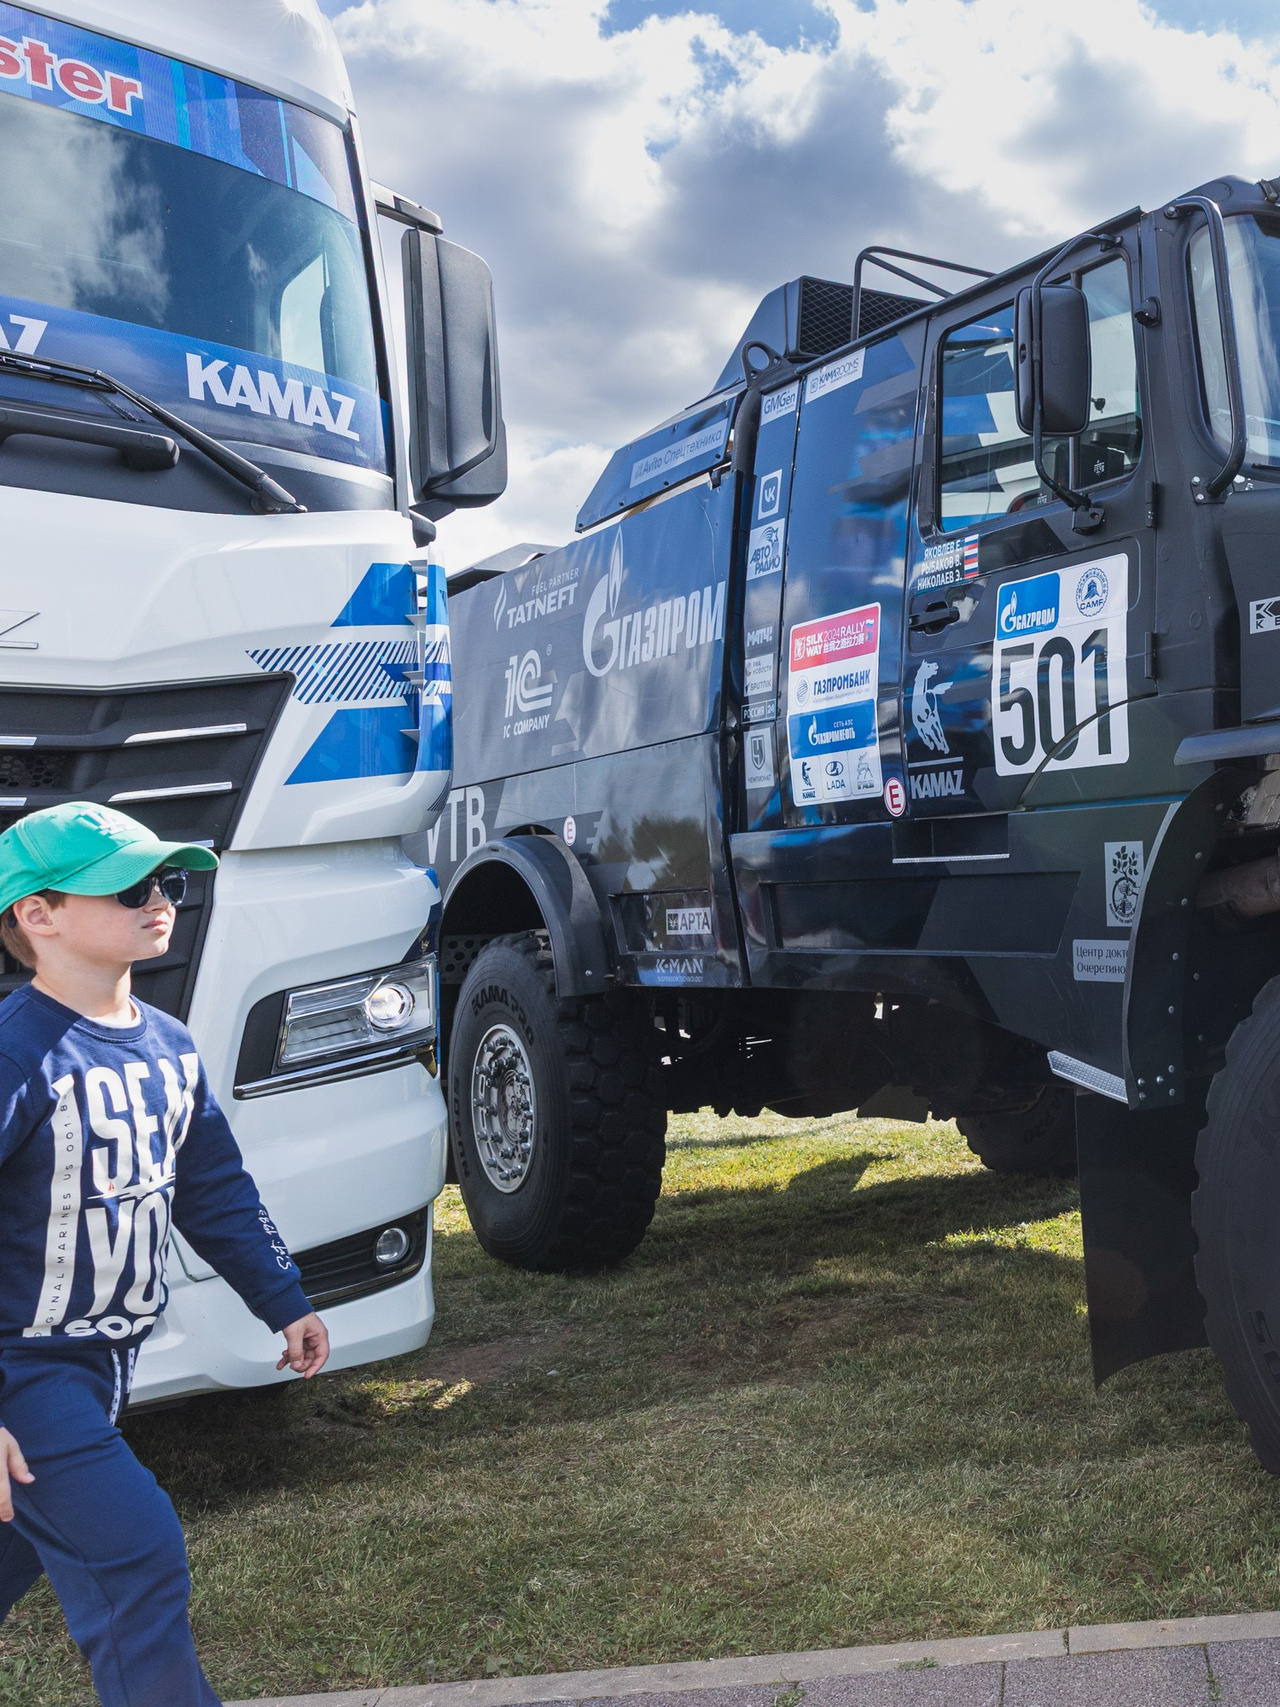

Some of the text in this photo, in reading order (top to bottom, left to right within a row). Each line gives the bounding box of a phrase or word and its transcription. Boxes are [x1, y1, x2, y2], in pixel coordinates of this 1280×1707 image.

[186, 352, 359, 440] KAMAZ
[642, 429, 722, 476] Avito Спецтехника
[750, 545, 771, 564] АВТО
[924, 541, 955, 561] ЯКОВЛЕВ
[754, 555, 781, 575] РАДИО
[921, 556, 954, 575] РЫБАКОВ
[531, 567, 579, 596] FUEL PARTNER
[917, 571, 954, 591] НИКОЛАЕВ
[507, 582, 578, 628] TATNEFT
[618, 581, 726, 670] ГАЗПРОМ
[1016, 607, 1056, 631] GAZPROM
[806, 621, 866, 646] SILK 2024 RALLY
[806, 644, 824, 657] WAY
[813, 669, 871, 695] ГАЗПРОМБАНК
[1000, 628, 1112, 766] 501
[743, 703, 775, 719] РОССИЯ 24
[513, 714, 550, 736] COMPANY
[826, 779, 846, 790] LADA
[909, 769, 965, 799] KAMAZ
[1076, 946, 1103, 958] Центр
[471, 985, 509, 1017] KAMA
[63, 1164, 74, 1180] US
[57, 1193, 72, 1263] MARINES
